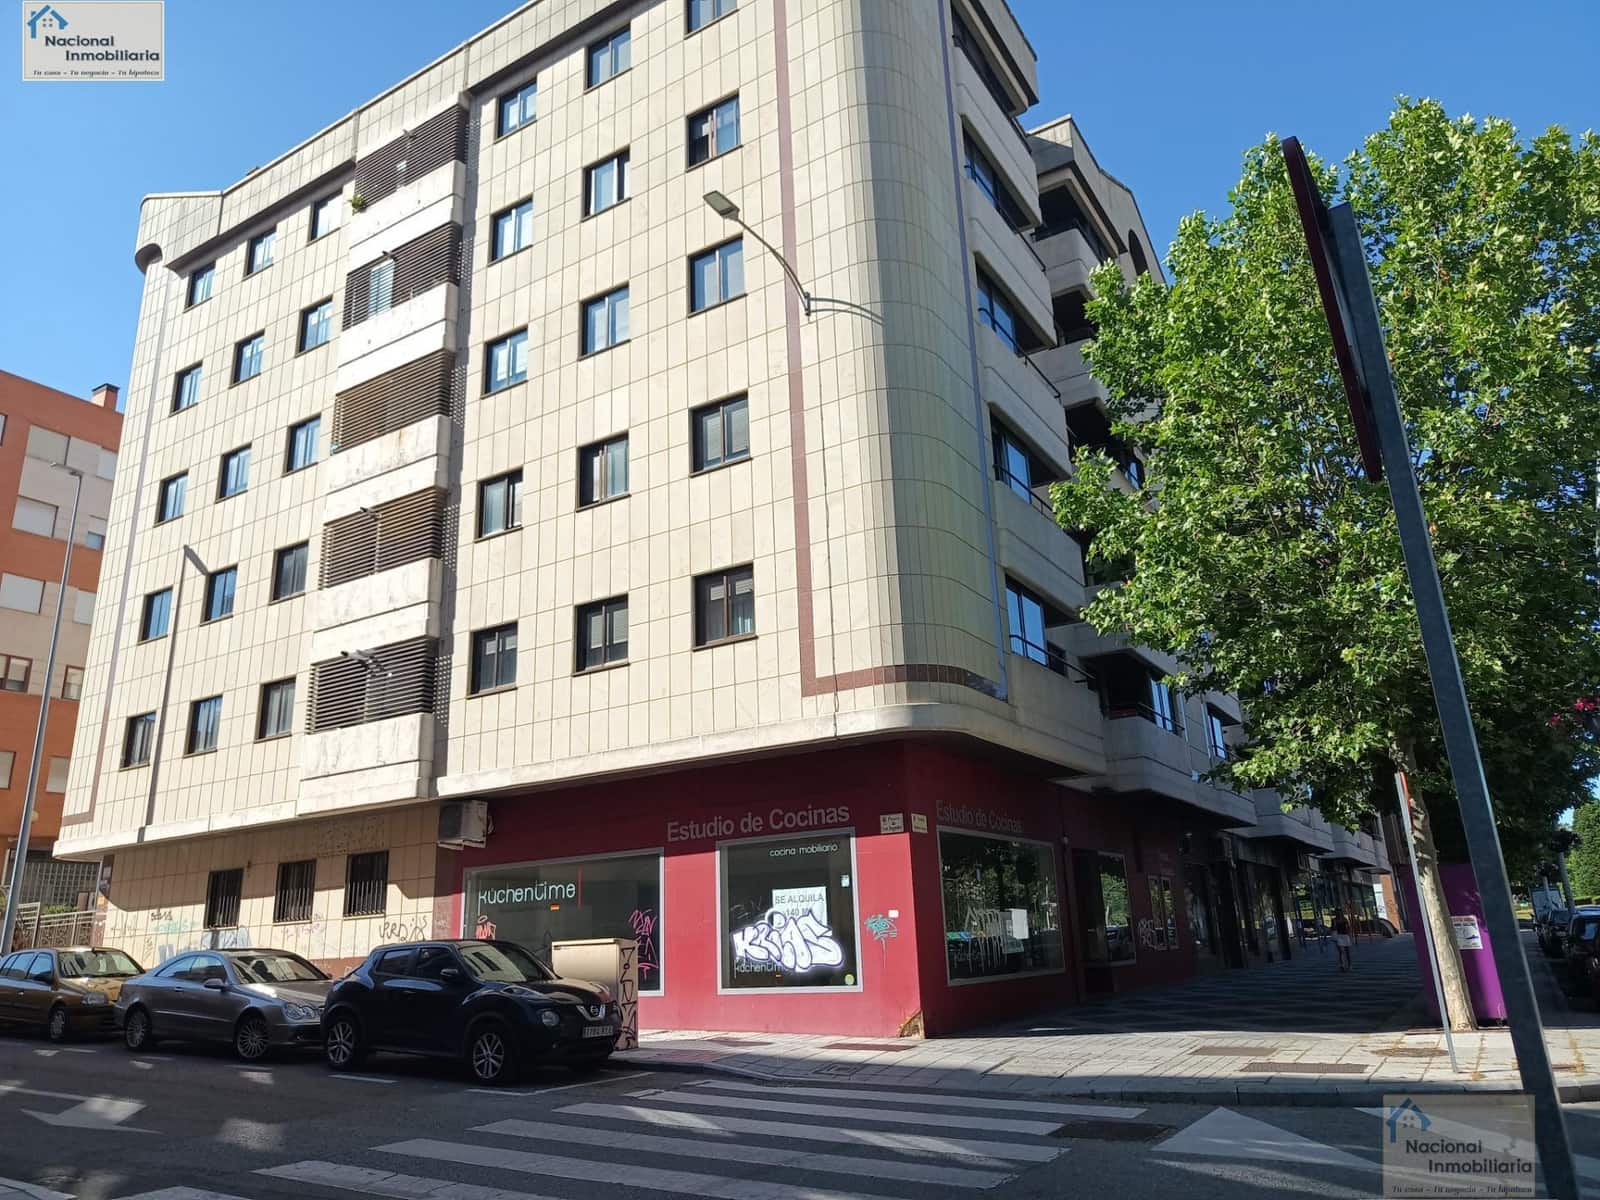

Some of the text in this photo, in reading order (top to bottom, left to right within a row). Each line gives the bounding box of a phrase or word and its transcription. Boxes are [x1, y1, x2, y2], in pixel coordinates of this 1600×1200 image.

[667, 805, 850, 842] Estudio de Cocinas
[936, 800, 974, 824] Estudio
[988, 809, 1024, 833] Cocinas
[769, 849, 796, 857] cocina
[774, 893, 825, 904] SE ALQUILA
